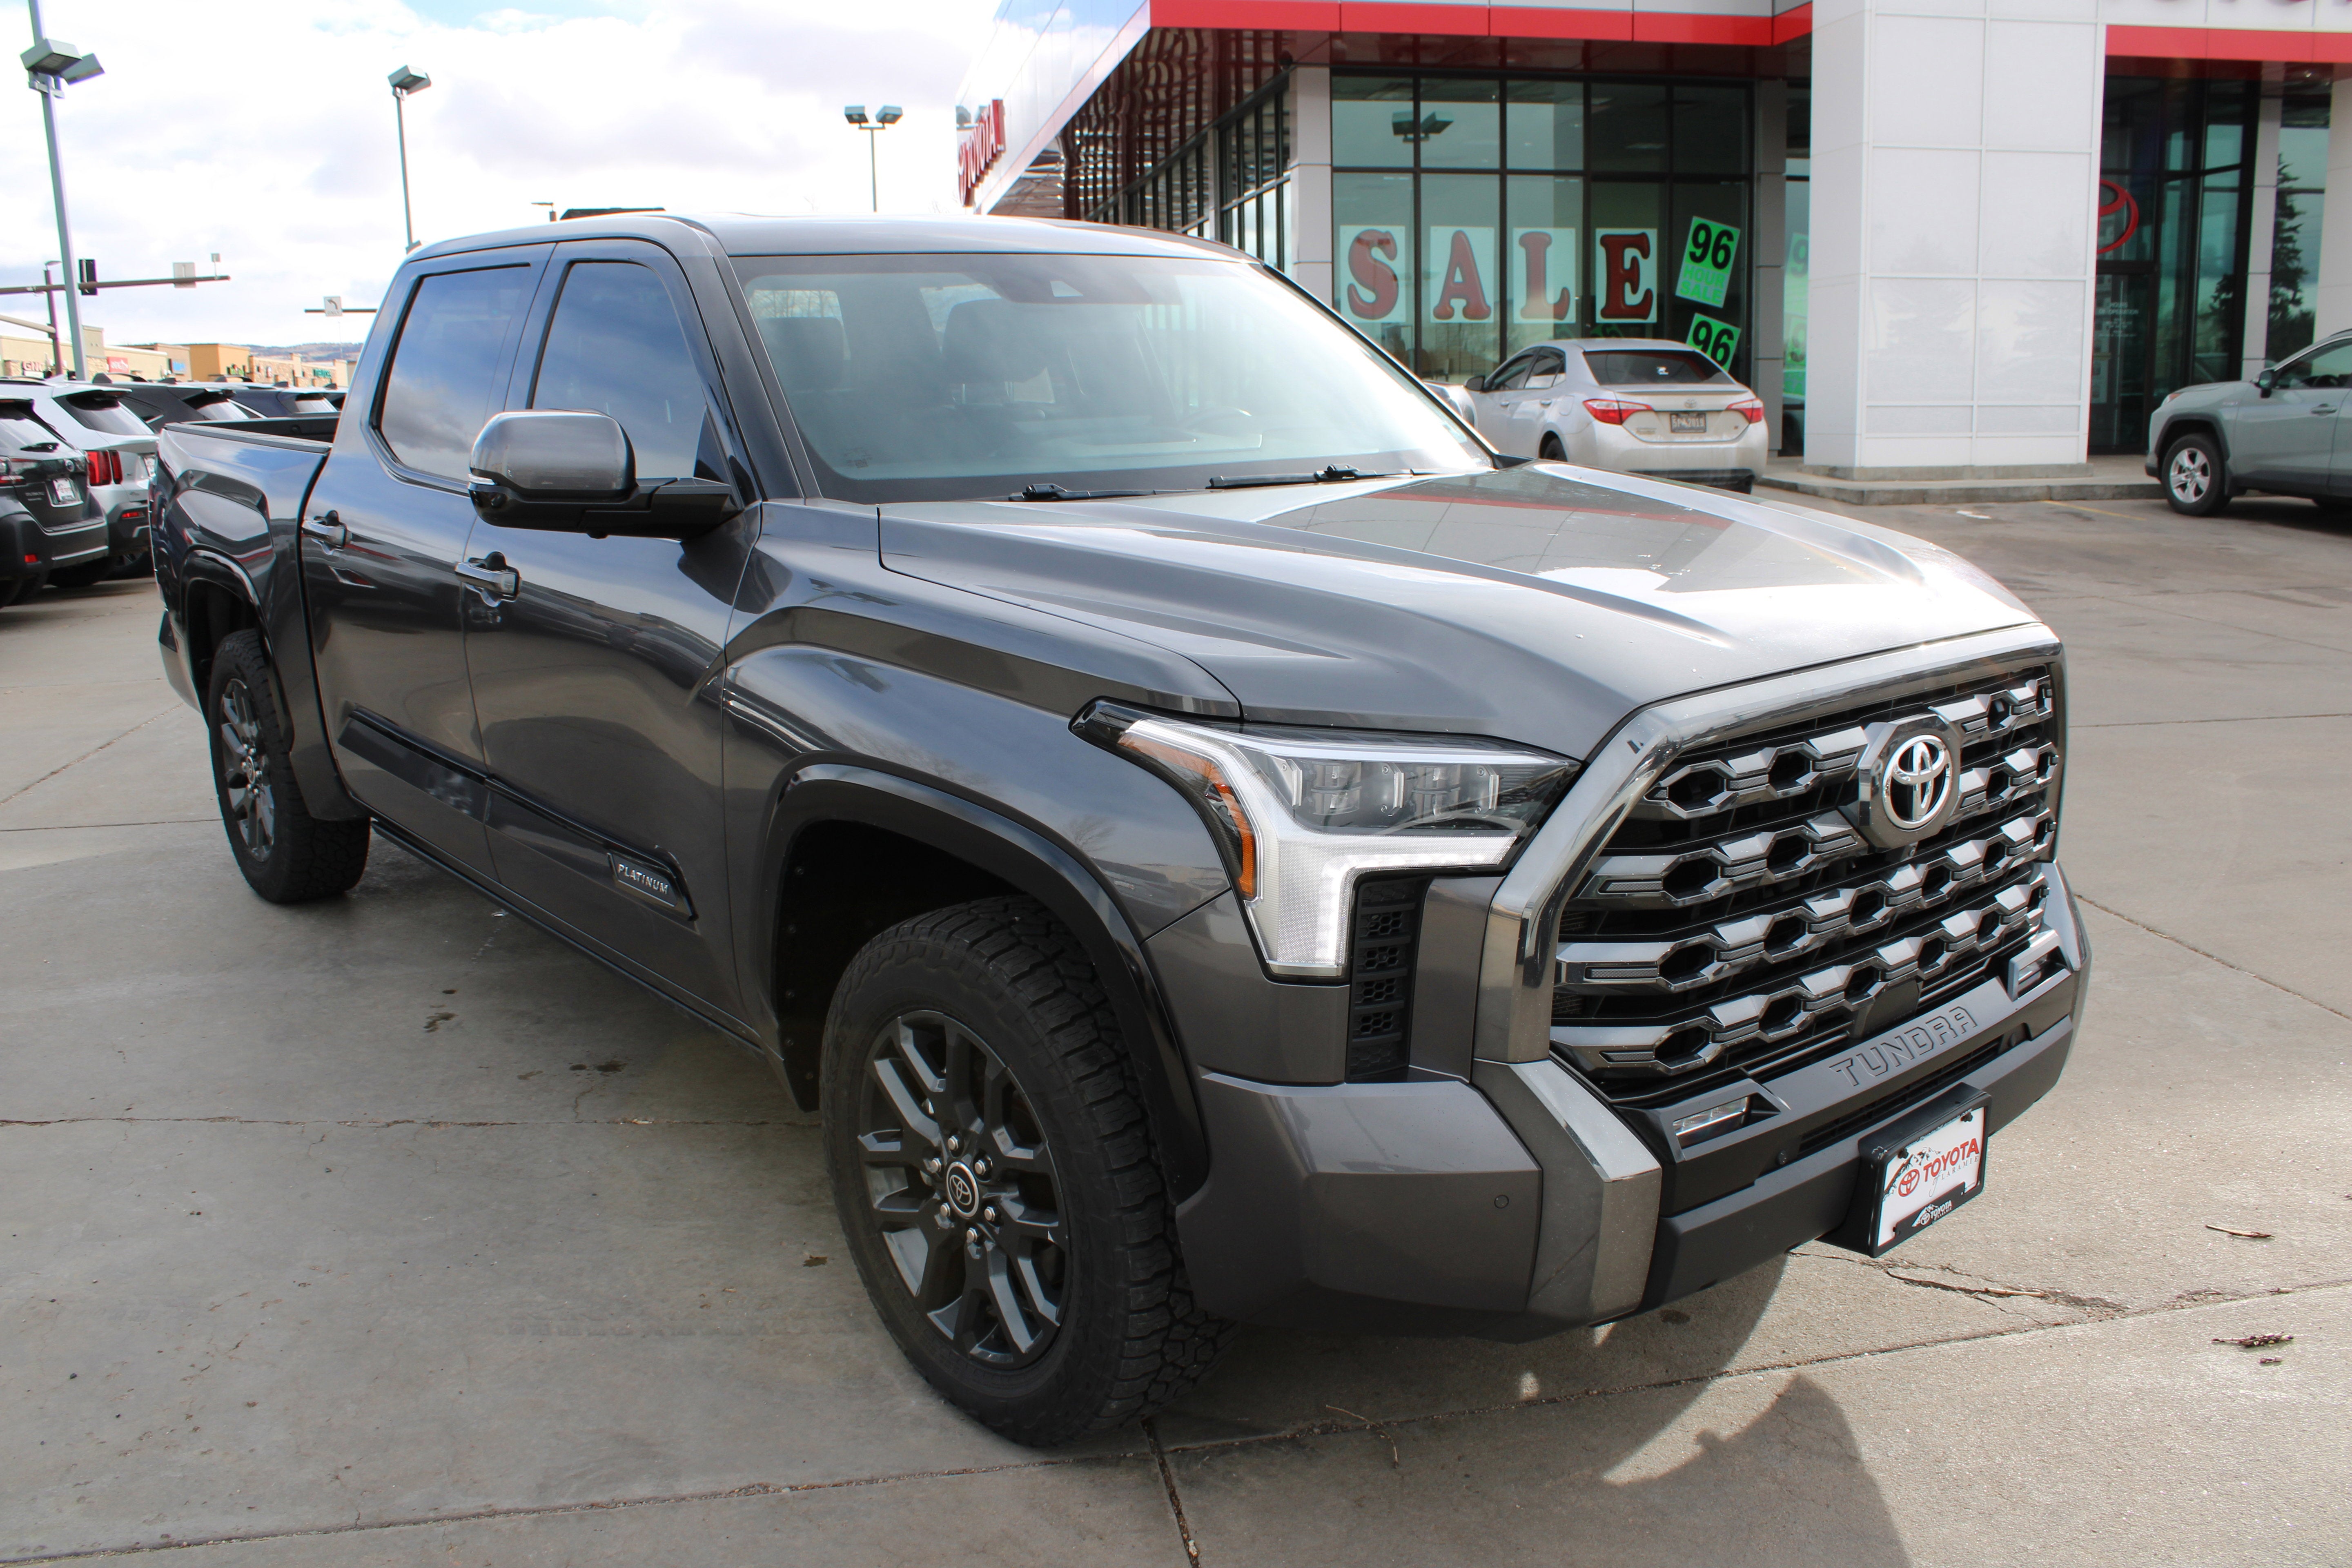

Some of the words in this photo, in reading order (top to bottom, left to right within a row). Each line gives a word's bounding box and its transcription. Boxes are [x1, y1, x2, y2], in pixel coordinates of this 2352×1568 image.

[1689, 223, 1734, 270] 96
[1347, 229, 1653, 321] SALE
[1679, 280, 1724, 305] SALE
[1683, 265, 1726, 289] HOUR
[1693, 320, 1734, 367] 96
[618, 864, 668, 894] PLATINUM
[1829, 1006, 1977, 1087] TUNDRA
[1923, 1138, 1979, 1182] TOYOTA
[1941, 1156, 1979, 1180] LARAMIE
[1930, 1200, 1952, 1219] TOYOTA
